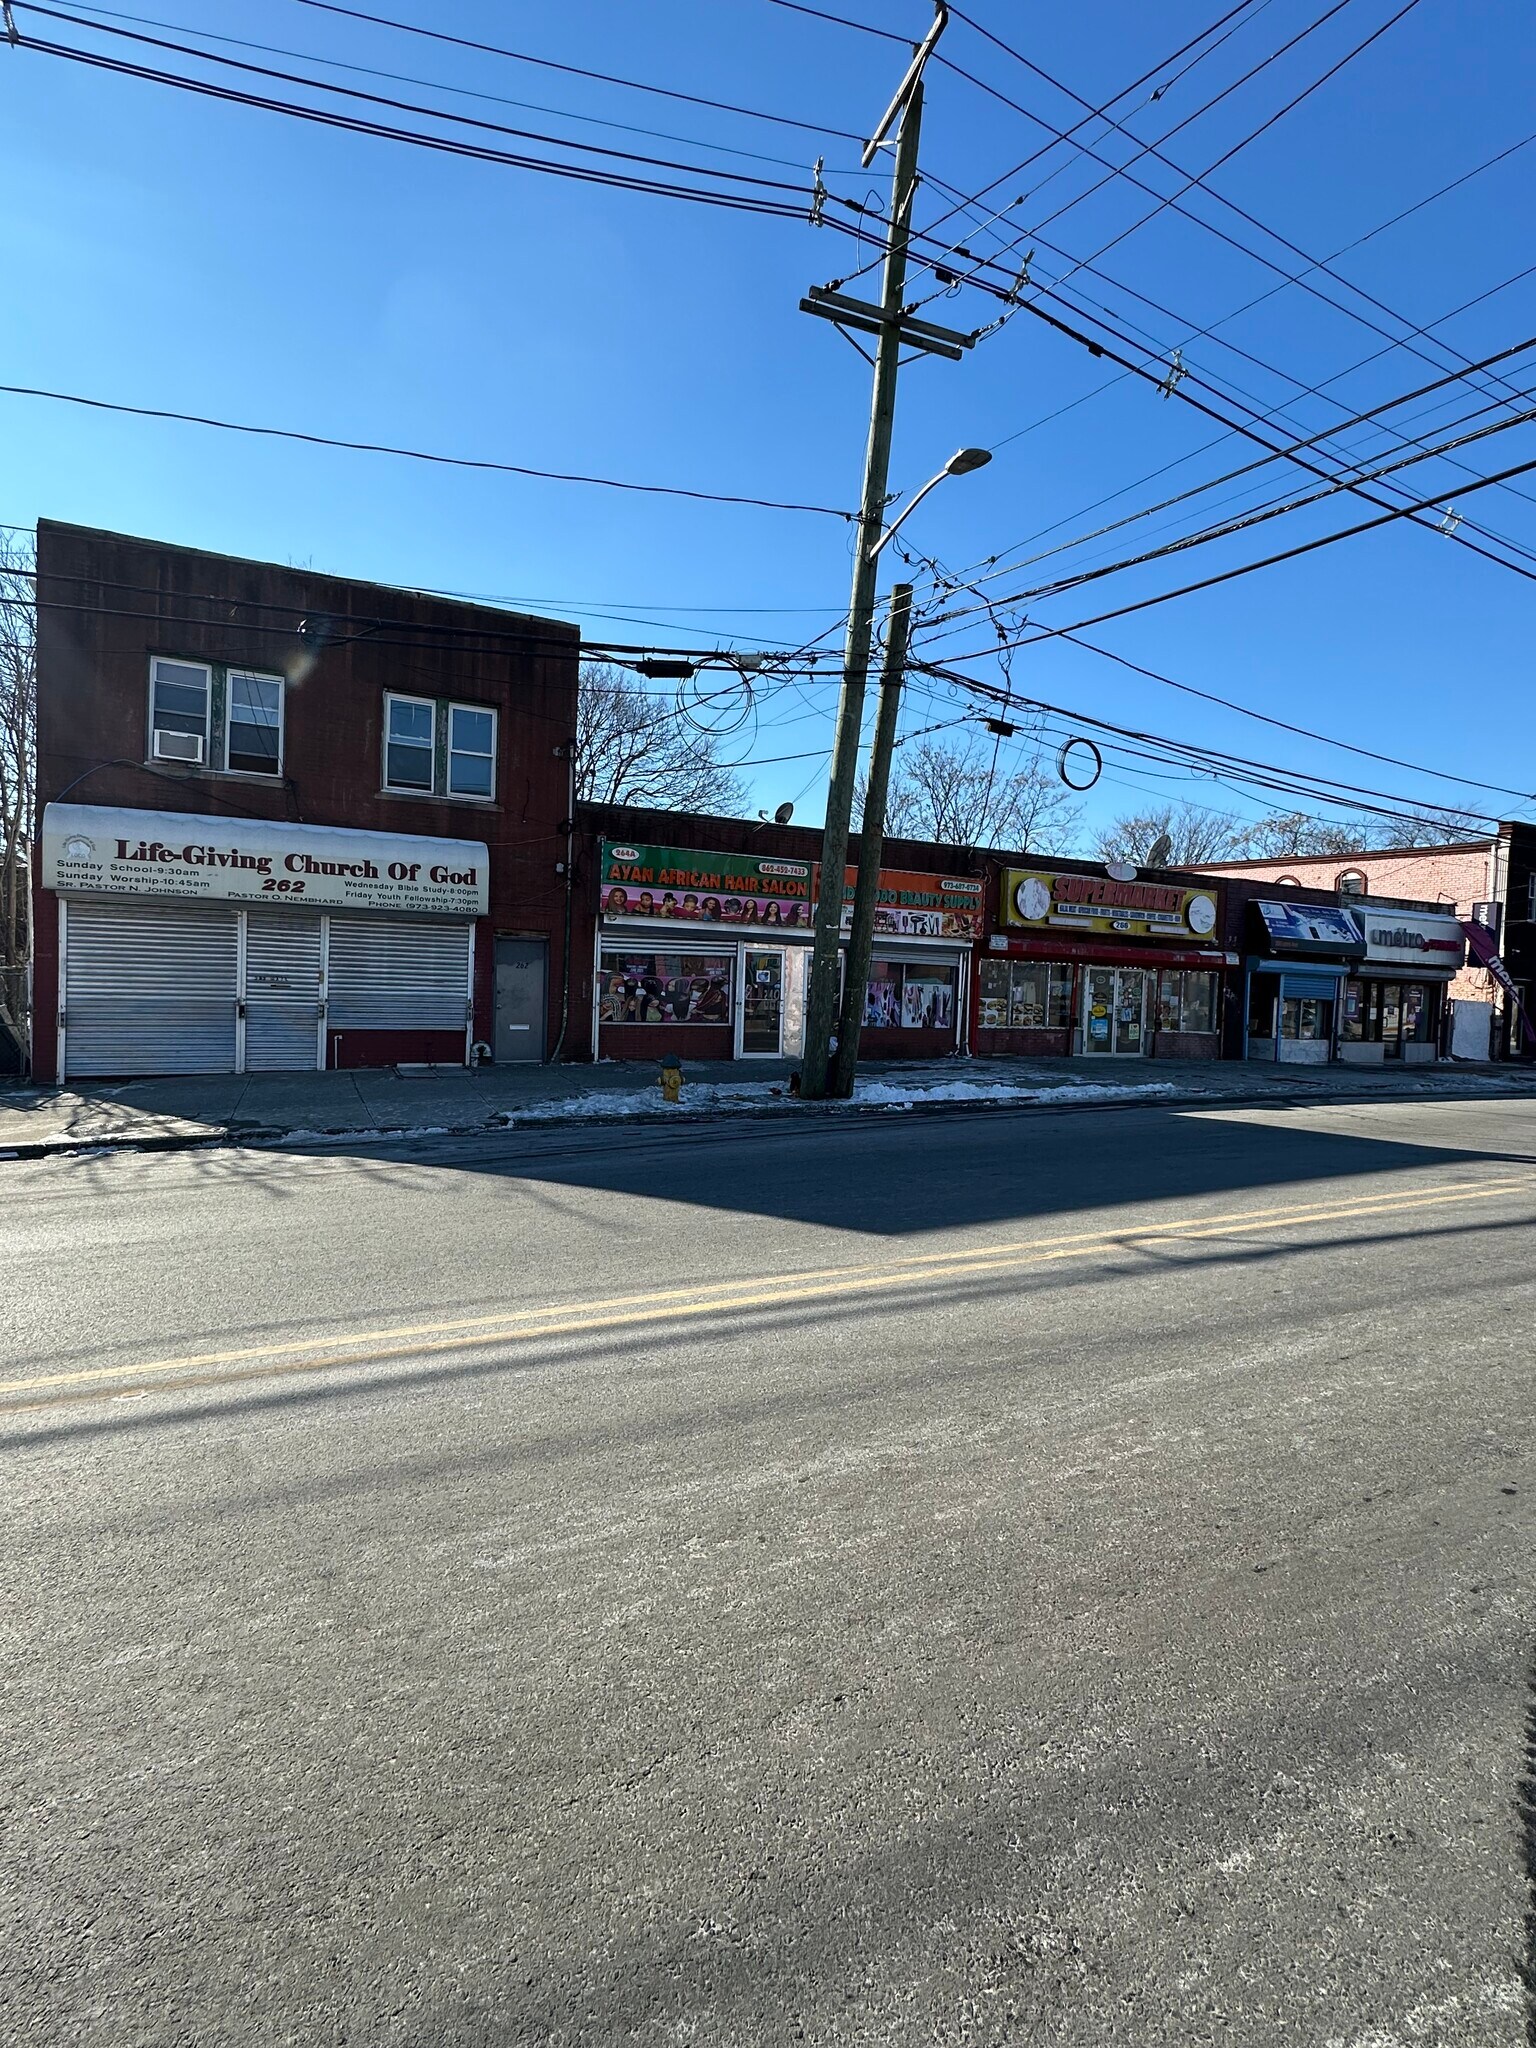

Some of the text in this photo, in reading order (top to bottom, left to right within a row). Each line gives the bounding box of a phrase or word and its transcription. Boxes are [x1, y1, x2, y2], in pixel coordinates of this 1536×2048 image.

[615, 849, 636, 857] 264A
[57, 859, 200, 877] Sunday School-9:30am
[114, 838, 273, 875] Life-Giving
[284, 853, 380, 879] Church
[388, 862, 421, 881] Of
[429, 865, 478, 886] God
[57, 870, 210, 888] Sunday Worship-10:45am
[262, 878, 306, 893] 262
[609, 863, 807, 896] AYAN AFRICAN HAIR SALON
[79, 882, 126, 891] PASTOR
[129, 884, 141, 892] N.
[144, 886, 198, 895] JOHNSON
[344, 880, 479, 896] Wednesday Bible Study-8:00pm
[1052, 876, 1187, 912] SUPERMARKET
[228, 891, 269, 900] PASTOR
[285, 895, 343, 905] NEMBHARD
[345, 890, 479, 905] Friday Youth Fellowship-7:30pm
[368, 900, 401, 908] PHONE
[900, 890, 942, 908] BEAUTY
[943, 894, 981, 910] SUPPLY
